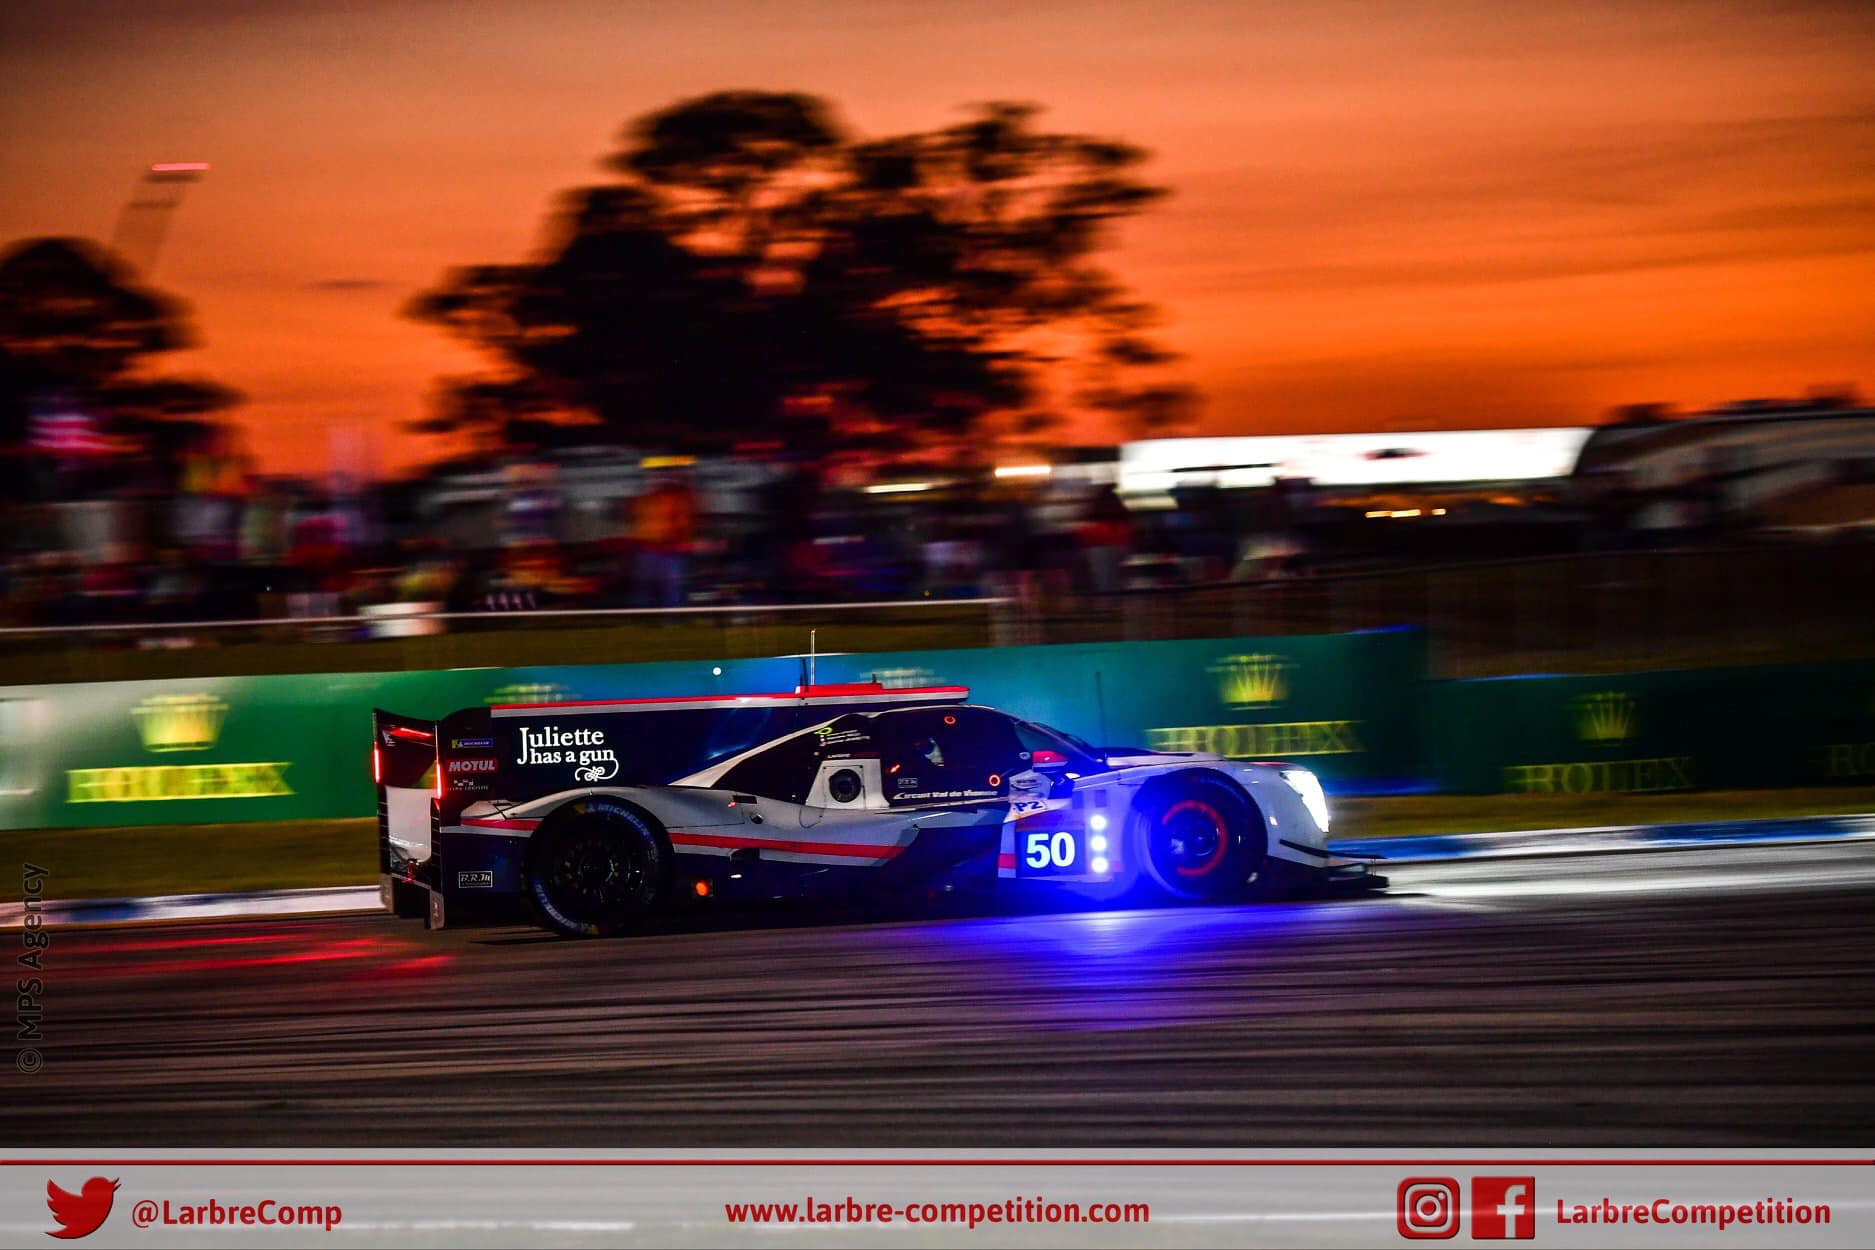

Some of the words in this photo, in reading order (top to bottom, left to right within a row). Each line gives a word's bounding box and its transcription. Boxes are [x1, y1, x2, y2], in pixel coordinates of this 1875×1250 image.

[517, 726, 604, 765] Juliette
[448, 760, 496, 772] MOTUL
[530, 748, 562, 764] has
[565, 750, 577, 763] a
[579, 749, 619, 766] gun
[1015, 801, 1043, 812] P2
[1026, 831, 1076, 869] 50
